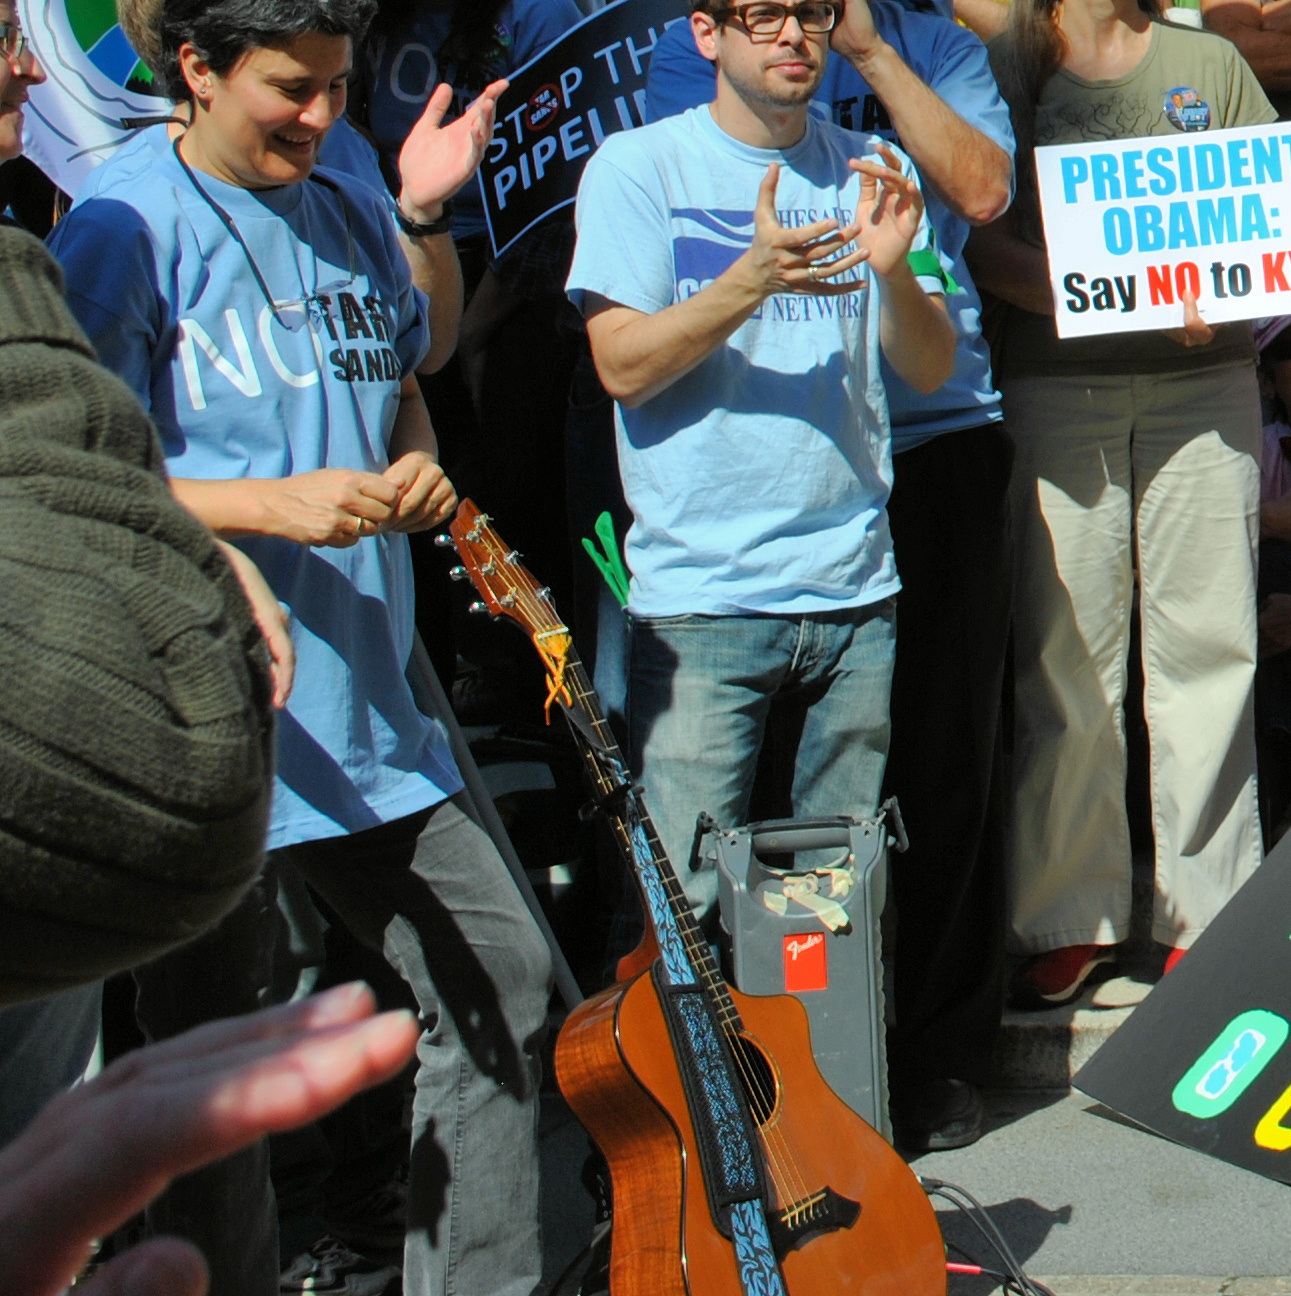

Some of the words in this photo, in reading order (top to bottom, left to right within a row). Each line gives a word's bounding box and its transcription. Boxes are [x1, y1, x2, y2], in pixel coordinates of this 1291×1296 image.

[833, 93, 892, 131] TA
[1102, 193, 1282, 255] OBAMA:
[1063, 272, 1136, 313] Say
[1146, 262, 1200, 306] NO
[1210, 261, 1251, 299] to
[314, 292, 391, 342] TAR
[179, 300, 324, 410] NO
